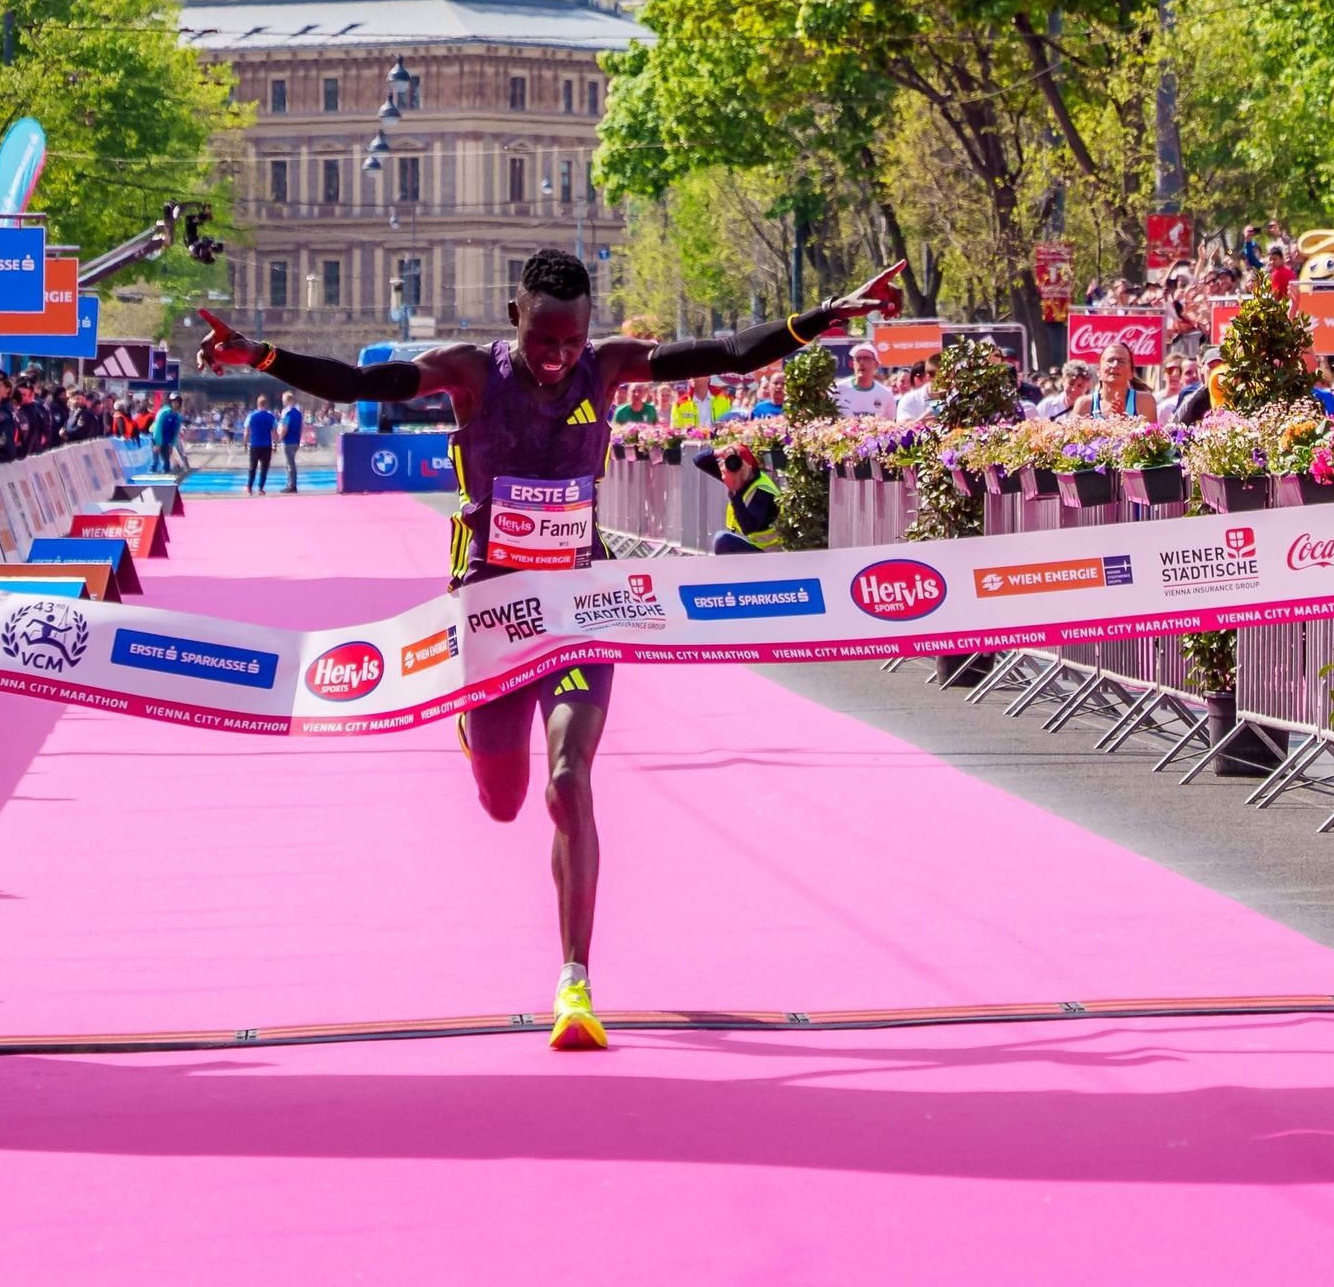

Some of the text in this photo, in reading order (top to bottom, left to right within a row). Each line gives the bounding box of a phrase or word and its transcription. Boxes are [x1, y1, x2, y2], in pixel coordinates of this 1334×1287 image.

[510, 484, 563, 503] ERSTE
[82, 526, 123, 538] WIENER
[498, 515, 588, 539] Hervis Fanny
[510, 553, 534, 563] WIEN
[535, 555, 572, 564] ENERGIE
[1159, 546, 1225, 565] WIENER
[1007, 571, 1042, 587] WIEN
[1045, 567, 1099, 583] ENERGIE
[1161, 559, 1259, 583] STÄDTISCHE
[573, 589, 631, 610] WIENER
[858, 574, 939, 608] Hervis
[1164, 581, 1260, 597] VIENNA INSURANCE GROUP
[693, 591, 798, 609] ERSTE SPARKASSE
[873, 602, 905, 613] SPORTS
[468, 597, 542, 633] POWER
[574, 603, 666, 625] STÄDTISCHE
[1216, 609, 1263, 625] VIENNA
[1264, 606, 1291, 620] CITY
[505, 617, 547, 643] ADE
[1060, 616, 1201, 640] VIENNA CITY MARATHON
[772, 643, 900, 659] VIENNA CITY MARATHON
[913, 631, 1046, 653] VIENNA CITY MARATHON
[21, 651, 64, 673] VCM
[129, 643, 248, 674] ERSTE SPARKASSE
[634, 649, 760, 661] VIENNA CITY MARATHON
[313, 650, 379, 690] Hervis
[499, 648, 623, 693] VIENNA CITY MARATHON
[29, 683, 57, 696] CITY
[60, 688, 129, 711] MARATHON
[320, 684, 349, 694] SPORTS
[145, 704, 289, 733] VIENNA CITY MARATHON
[302, 714, 414, 733] VIENNA CITY MARATHON
